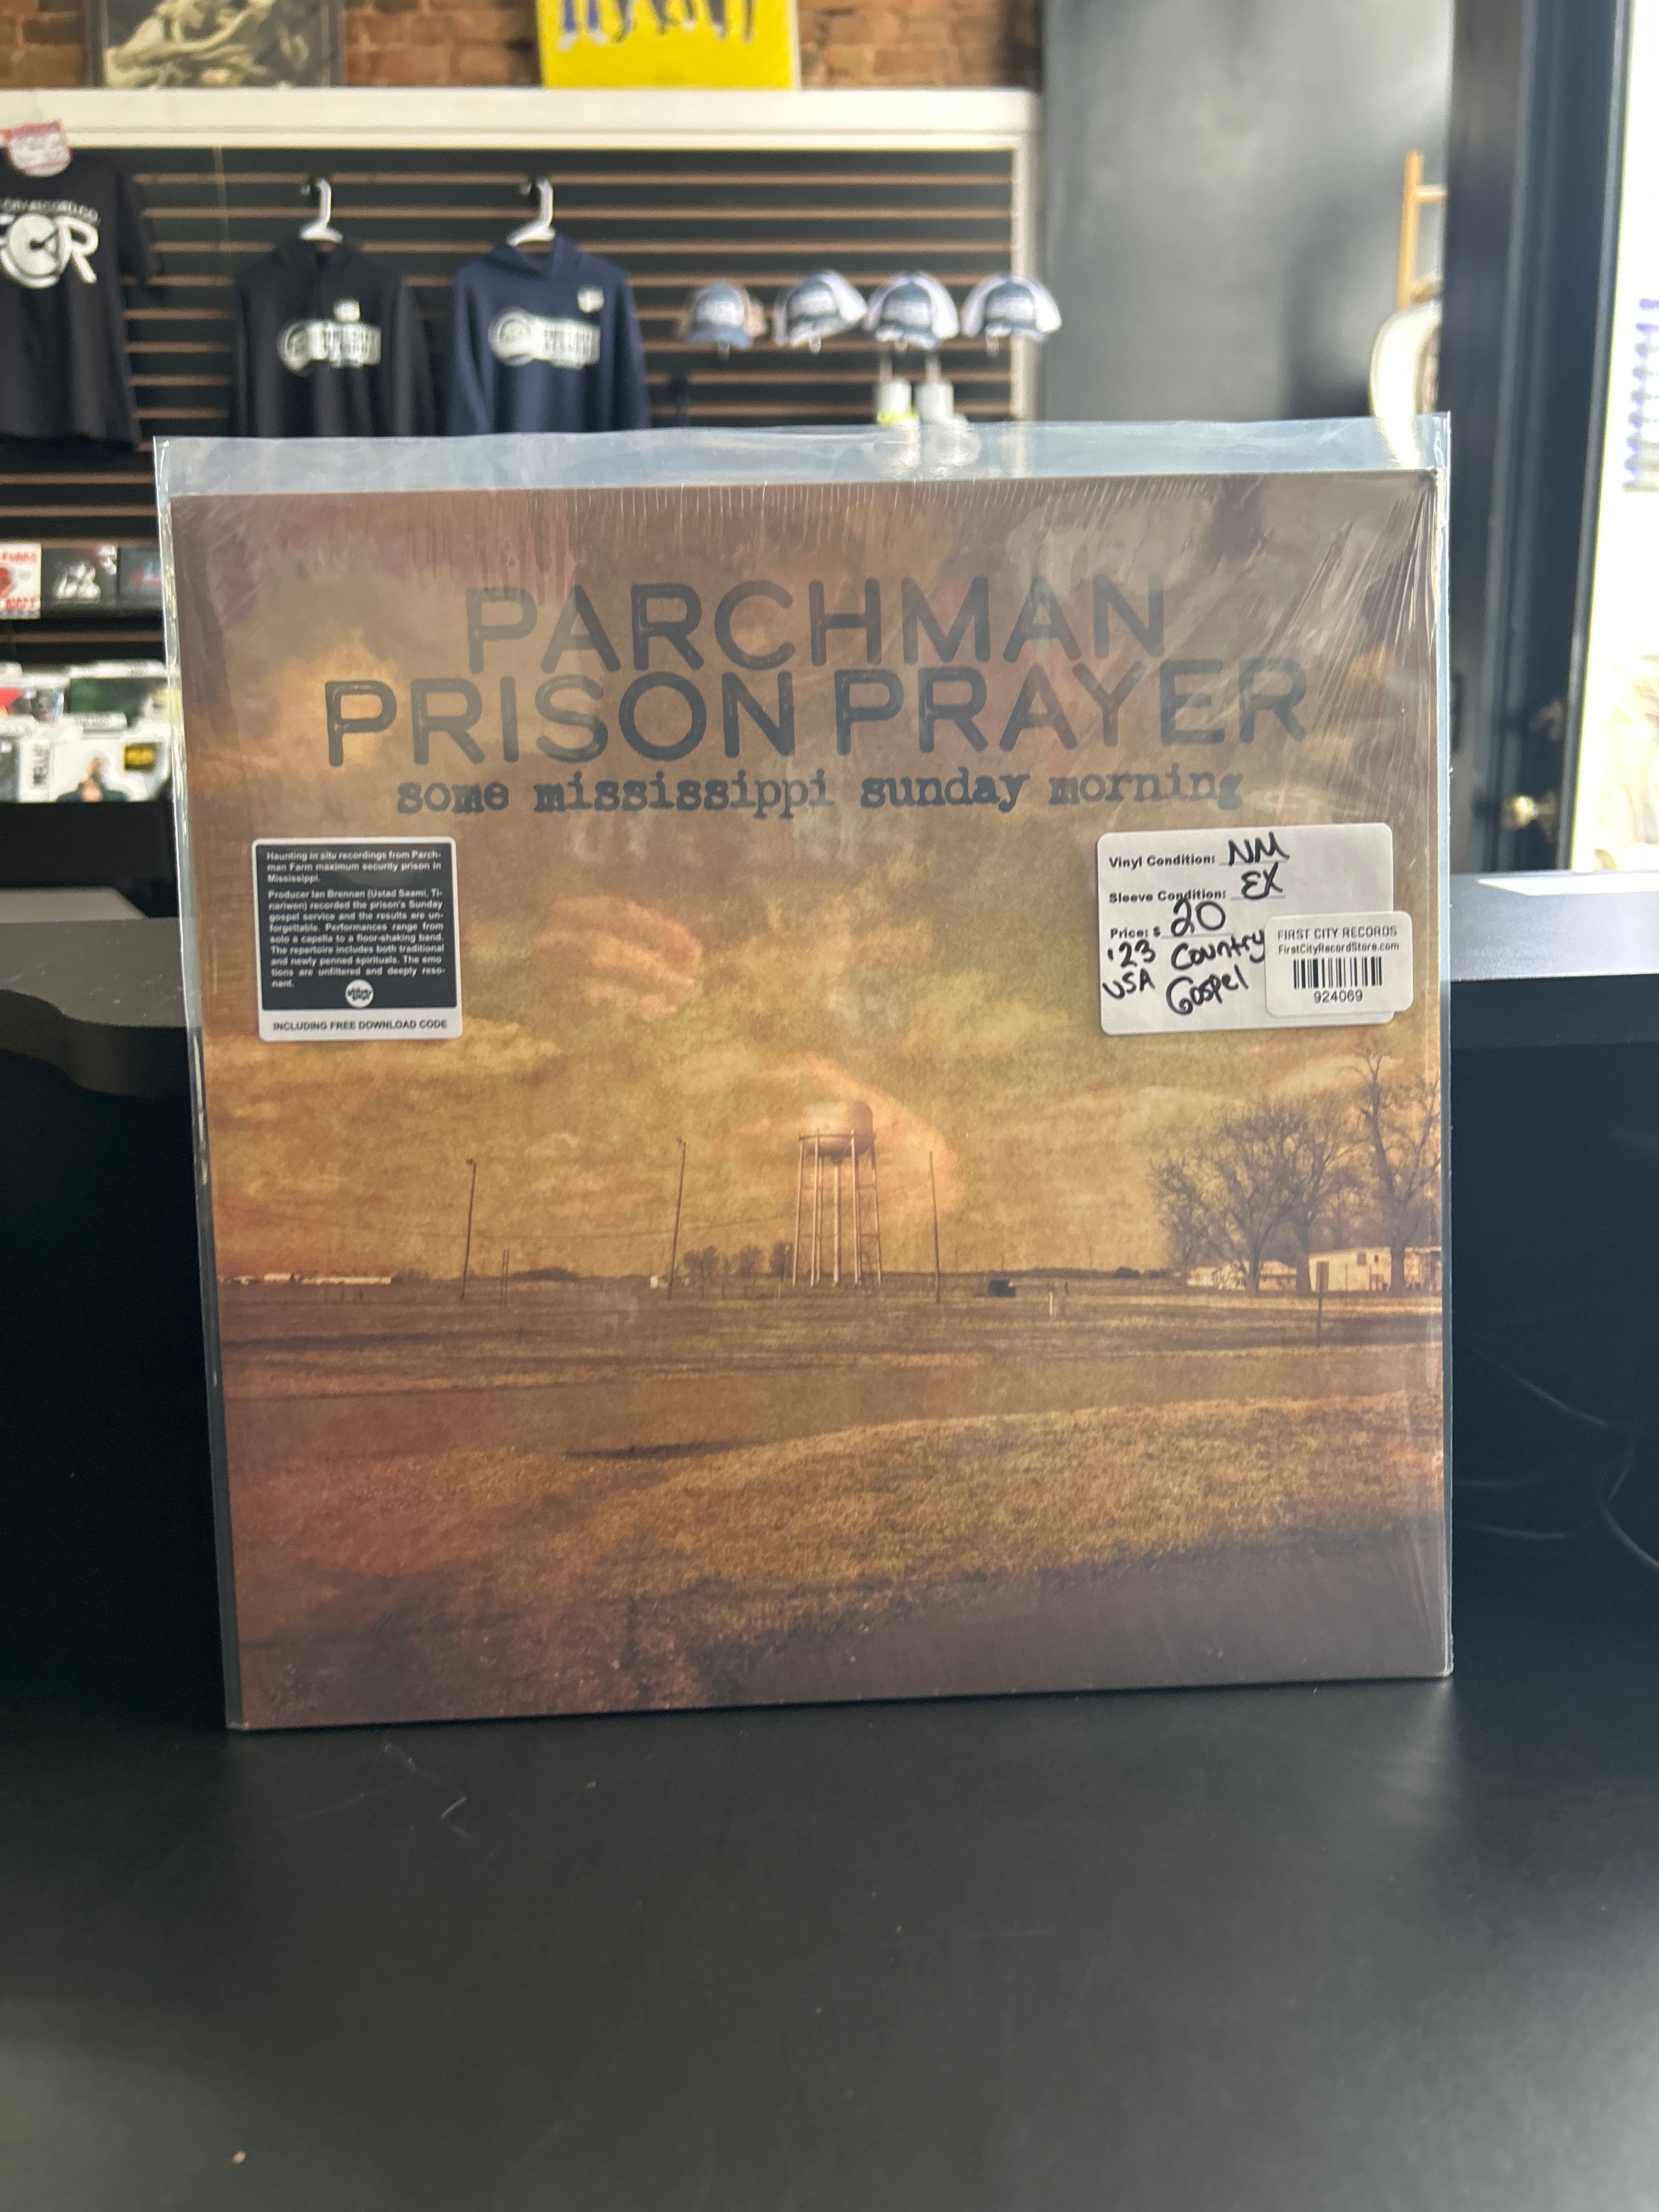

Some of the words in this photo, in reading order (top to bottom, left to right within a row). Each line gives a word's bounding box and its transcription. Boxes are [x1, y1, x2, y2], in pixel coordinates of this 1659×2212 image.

[466, 573, 1165, 674] PARCHMAN
[325, 670, 795, 767] PRISON
[834, 658, 1307, 756] PRAYER
[397, 781, 509, 814] some
[534, 769, 833, 820] mississippi
[861, 766, 1030, 812] sunday
[1048, 763, 1243, 811] morning
[267, 851, 307, 862] Haunting
[338, 850, 387, 861] recordings
[389, 850, 410, 860] from
[1109, 855, 1142, 871] Vinyl
[1147, 854, 1215, 867] Condition:
[1228, 831, 1290, 866] NM
[267, 864, 287, 872] man
[289, 862, 313, 872] Farm
[315, 862, 359, 872] maximum
[363, 862, 398, 873] security
[401, 862, 430, 872] prison
[433, 861, 441, 870] in
[1109, 892, 1153, 904] Sleeve
[1158, 888, 1226, 901] Condition:
[1240, 861, 1283, 900] EX
[268, 889, 309, 899] Producer
[310, 900, 351, 910] recorded
[352, 900, 367, 910] the
[303, 912, 335, 921] service
[338, 912, 356, 921] and
[358, 912, 373, 921] the
[376, 911, 407, 921] results
[1110, 927, 1148, 939] Price:
[1171, 897, 1226, 936] 20
[325, 923, 387, 932] Performances
[392, 923, 418, 932] range
[422, 922, 444, 931] from
[1278, 928, 1310, 940] FIRST
[1314, 927, 1338, 940] CITY
[1342, 925, 1397, 939] RECORDS
[271, 945, 287, 955] The
[290, 945, 334, 955] repertoire
[336, 944, 374, 954] includes
[376, 944, 397, 953] both
[399, 944, 444, 953] traditional
[1171, 928, 1265, 970] Country
[271, 957, 288, 966] and
[290, 956, 317, 967] newly
[403, 955, 419, 964] The
[318, 967, 361, 977] unfiltered
[365, 966, 382, 976] and
[387, 967, 417, 977] deeply
[1102, 968, 1155, 999] USA
[1166, 963, 1249, 1015] Gospel
[1314, 989, 1363, 1003] 924069
[273, 1021, 328, 1031] INCLUDING
[330, 1020, 356, 1030] FREE
[358, 1019, 416, 1030] DOWNLOAD
[419, 1019, 447, 1029] CODE
